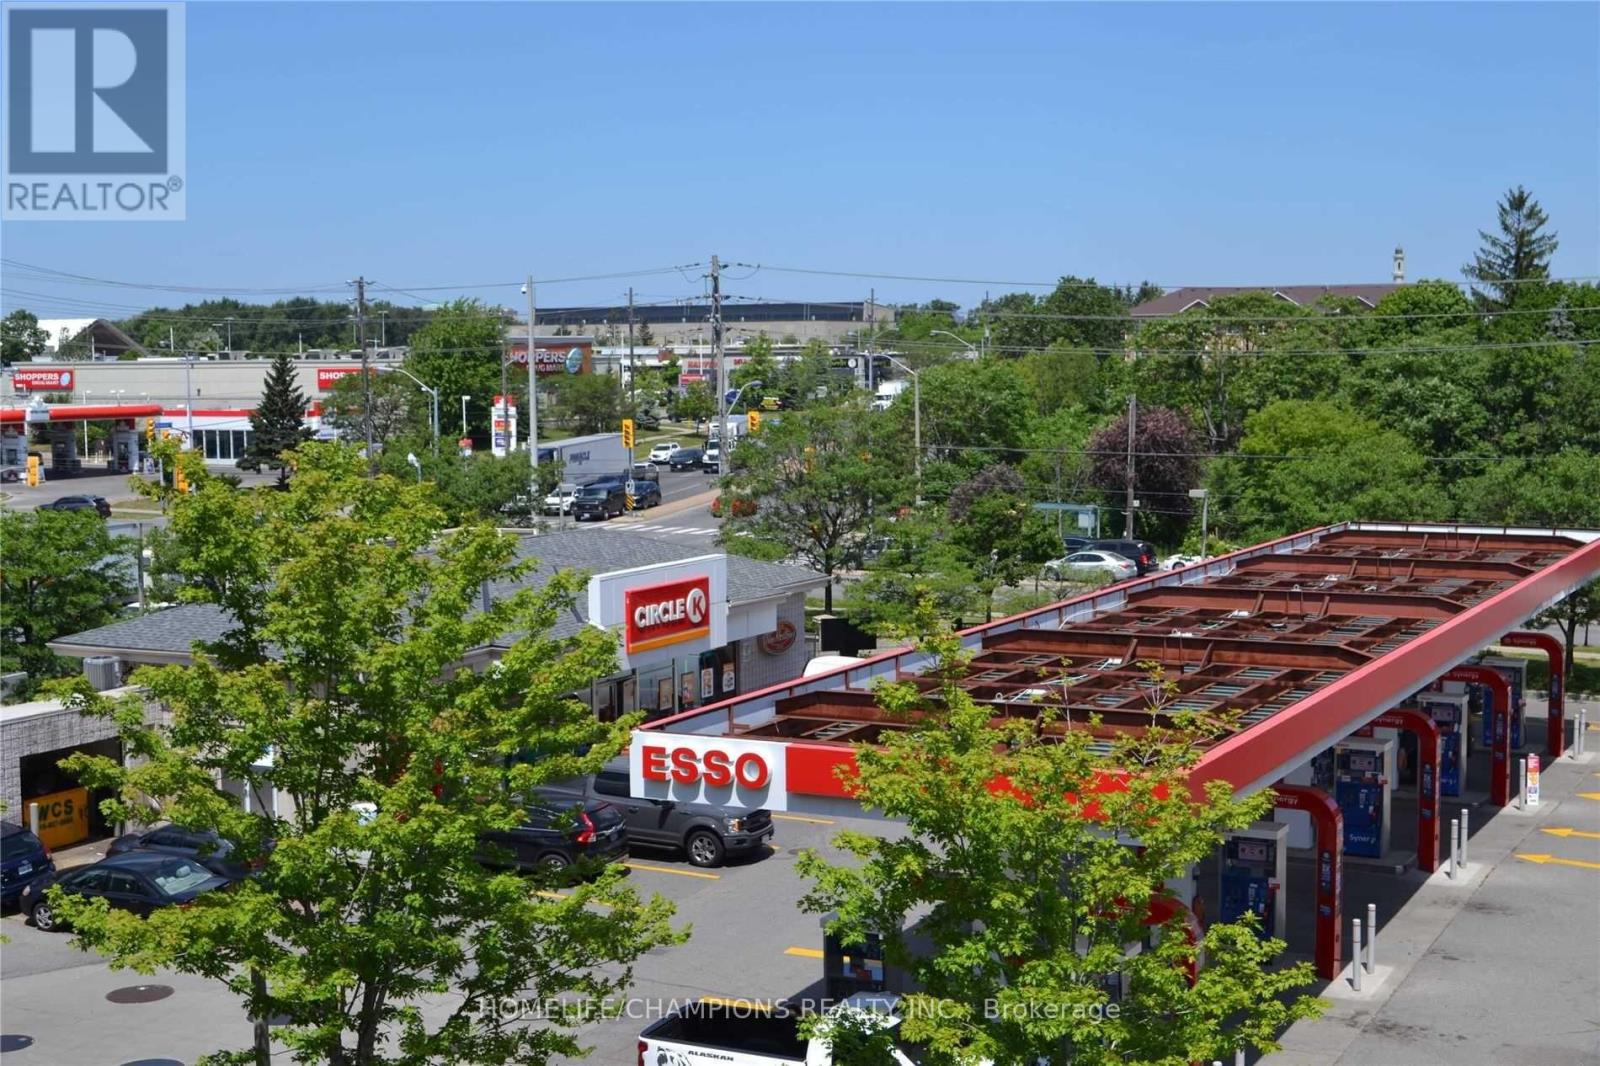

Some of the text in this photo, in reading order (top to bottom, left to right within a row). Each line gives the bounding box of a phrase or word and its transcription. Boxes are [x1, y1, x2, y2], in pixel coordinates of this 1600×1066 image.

[634, 588, 706, 629] CIRCLE K
[642, 745, 769, 790] ESSO
[687, 1050, 735, 1062] ALASKAN
